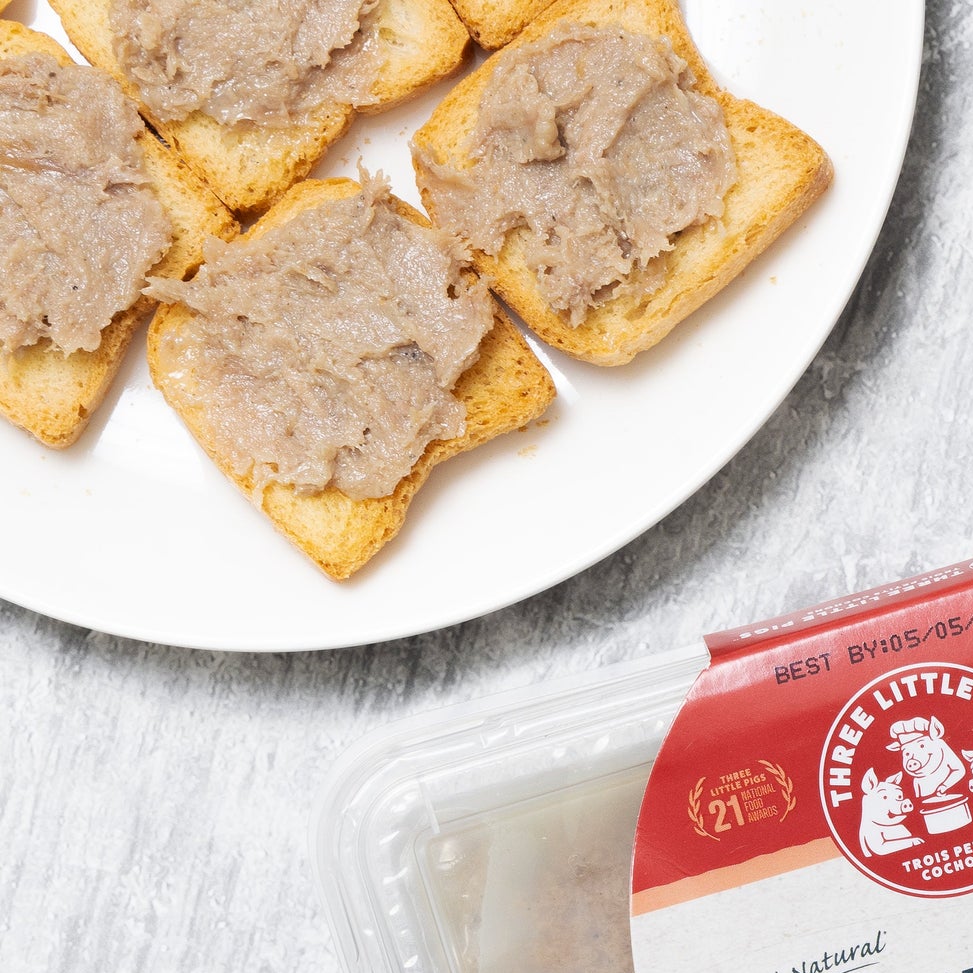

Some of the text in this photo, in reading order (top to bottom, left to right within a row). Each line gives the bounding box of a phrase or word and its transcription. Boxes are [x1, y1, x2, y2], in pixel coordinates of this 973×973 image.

[774, 652, 832, 685] BEST
[829, 705, 876, 808] THREE
[709, 773, 767, 798] LITTLE PIGS
[719, 767, 752, 785] THREE
[740, 783, 777, 802] NATIONAL
[707, 794, 746, 834] 21
[743, 798, 764, 813] FOOD
[746, 805, 779, 824] AWARDS
[901, 849, 951, 874] TROIS
